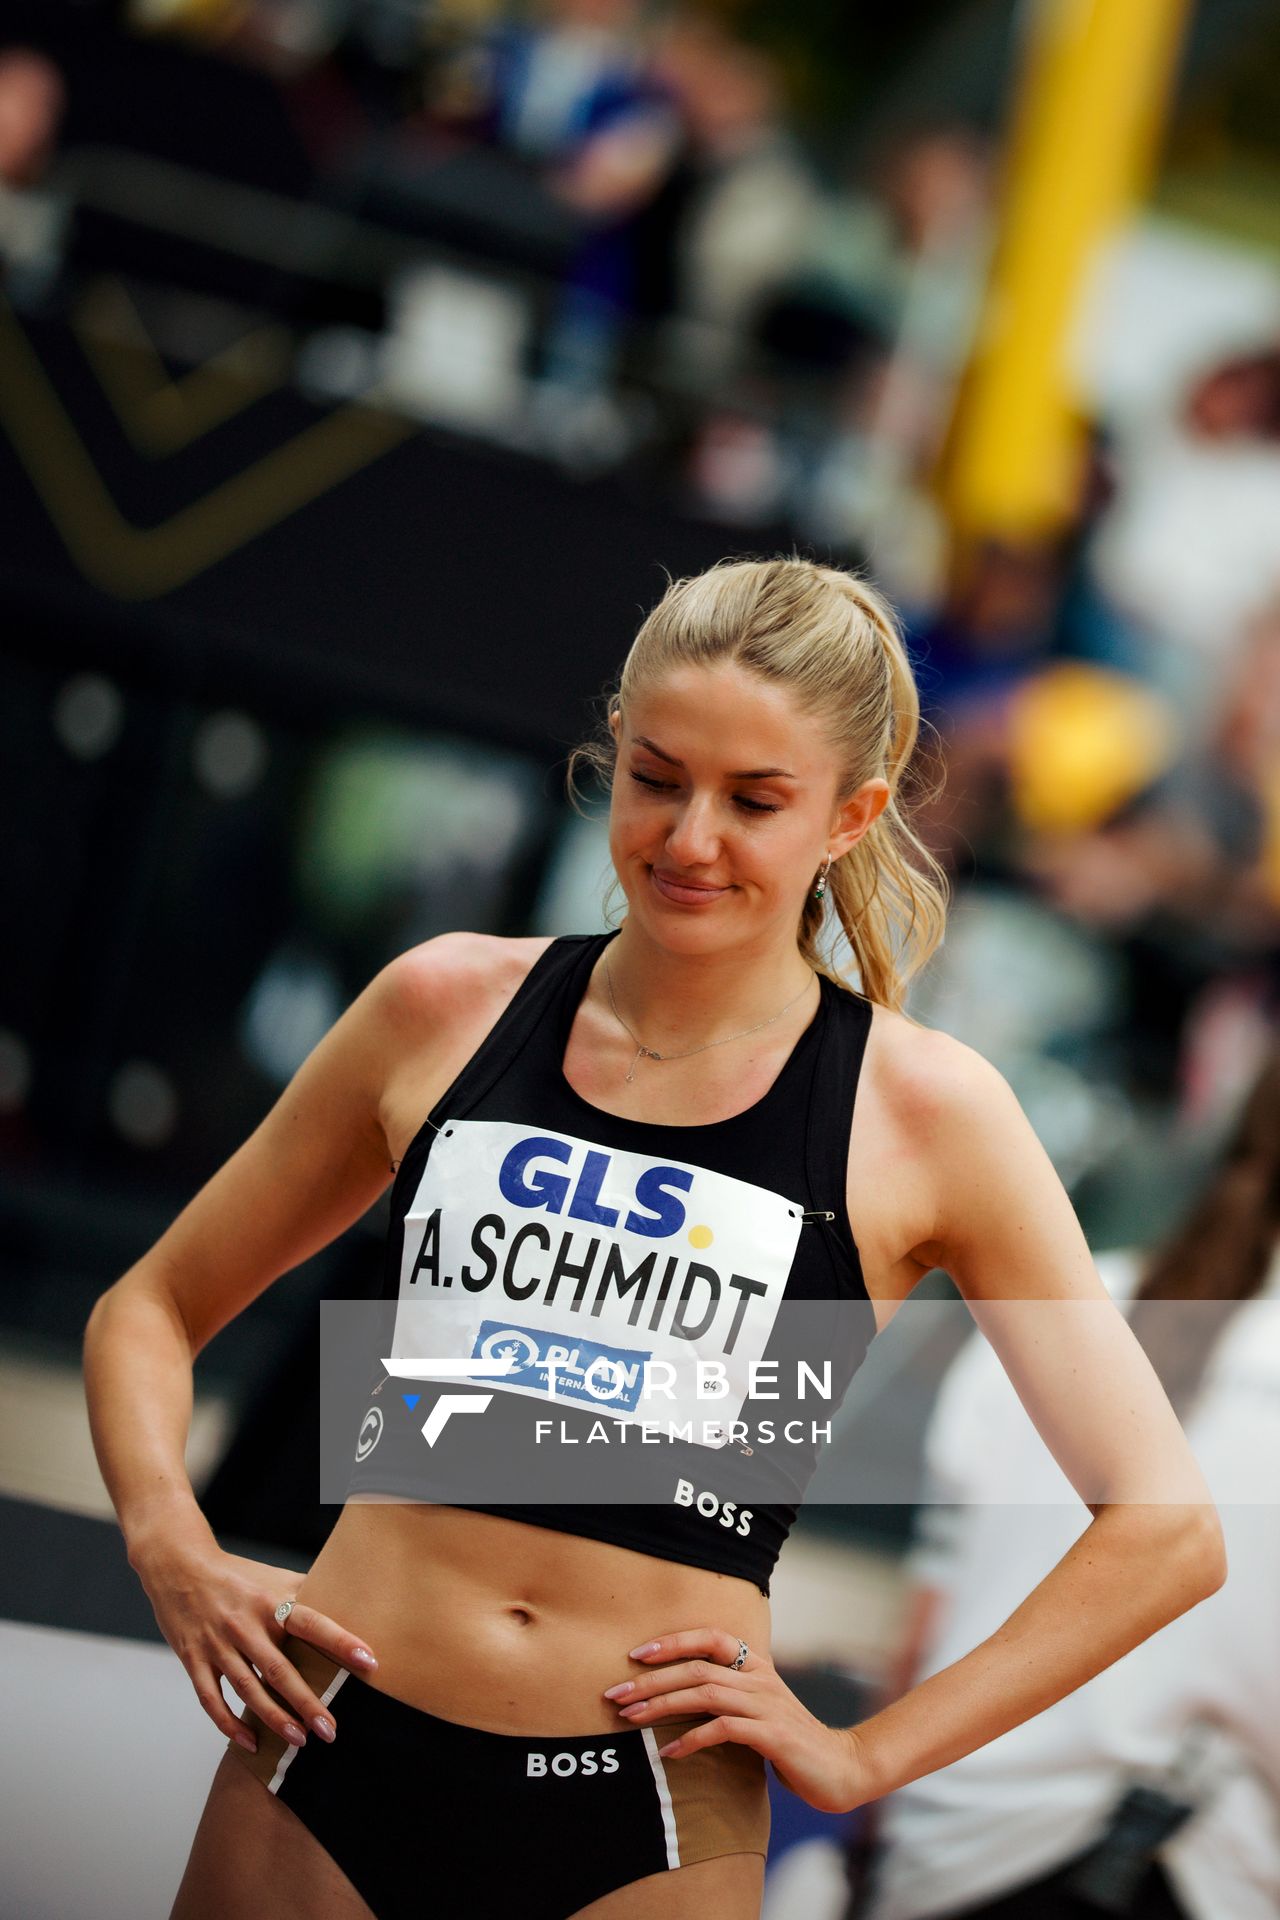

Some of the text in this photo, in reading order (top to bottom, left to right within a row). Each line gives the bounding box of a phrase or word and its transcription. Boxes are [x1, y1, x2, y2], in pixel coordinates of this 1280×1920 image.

[409, 1208, 768, 1355] A.SCHMIDT
[539, 1372, 631, 1403] INERNAIOAL
[674, 1478, 754, 1537] BOSS
[526, 1748, 620, 1777] BOSS
